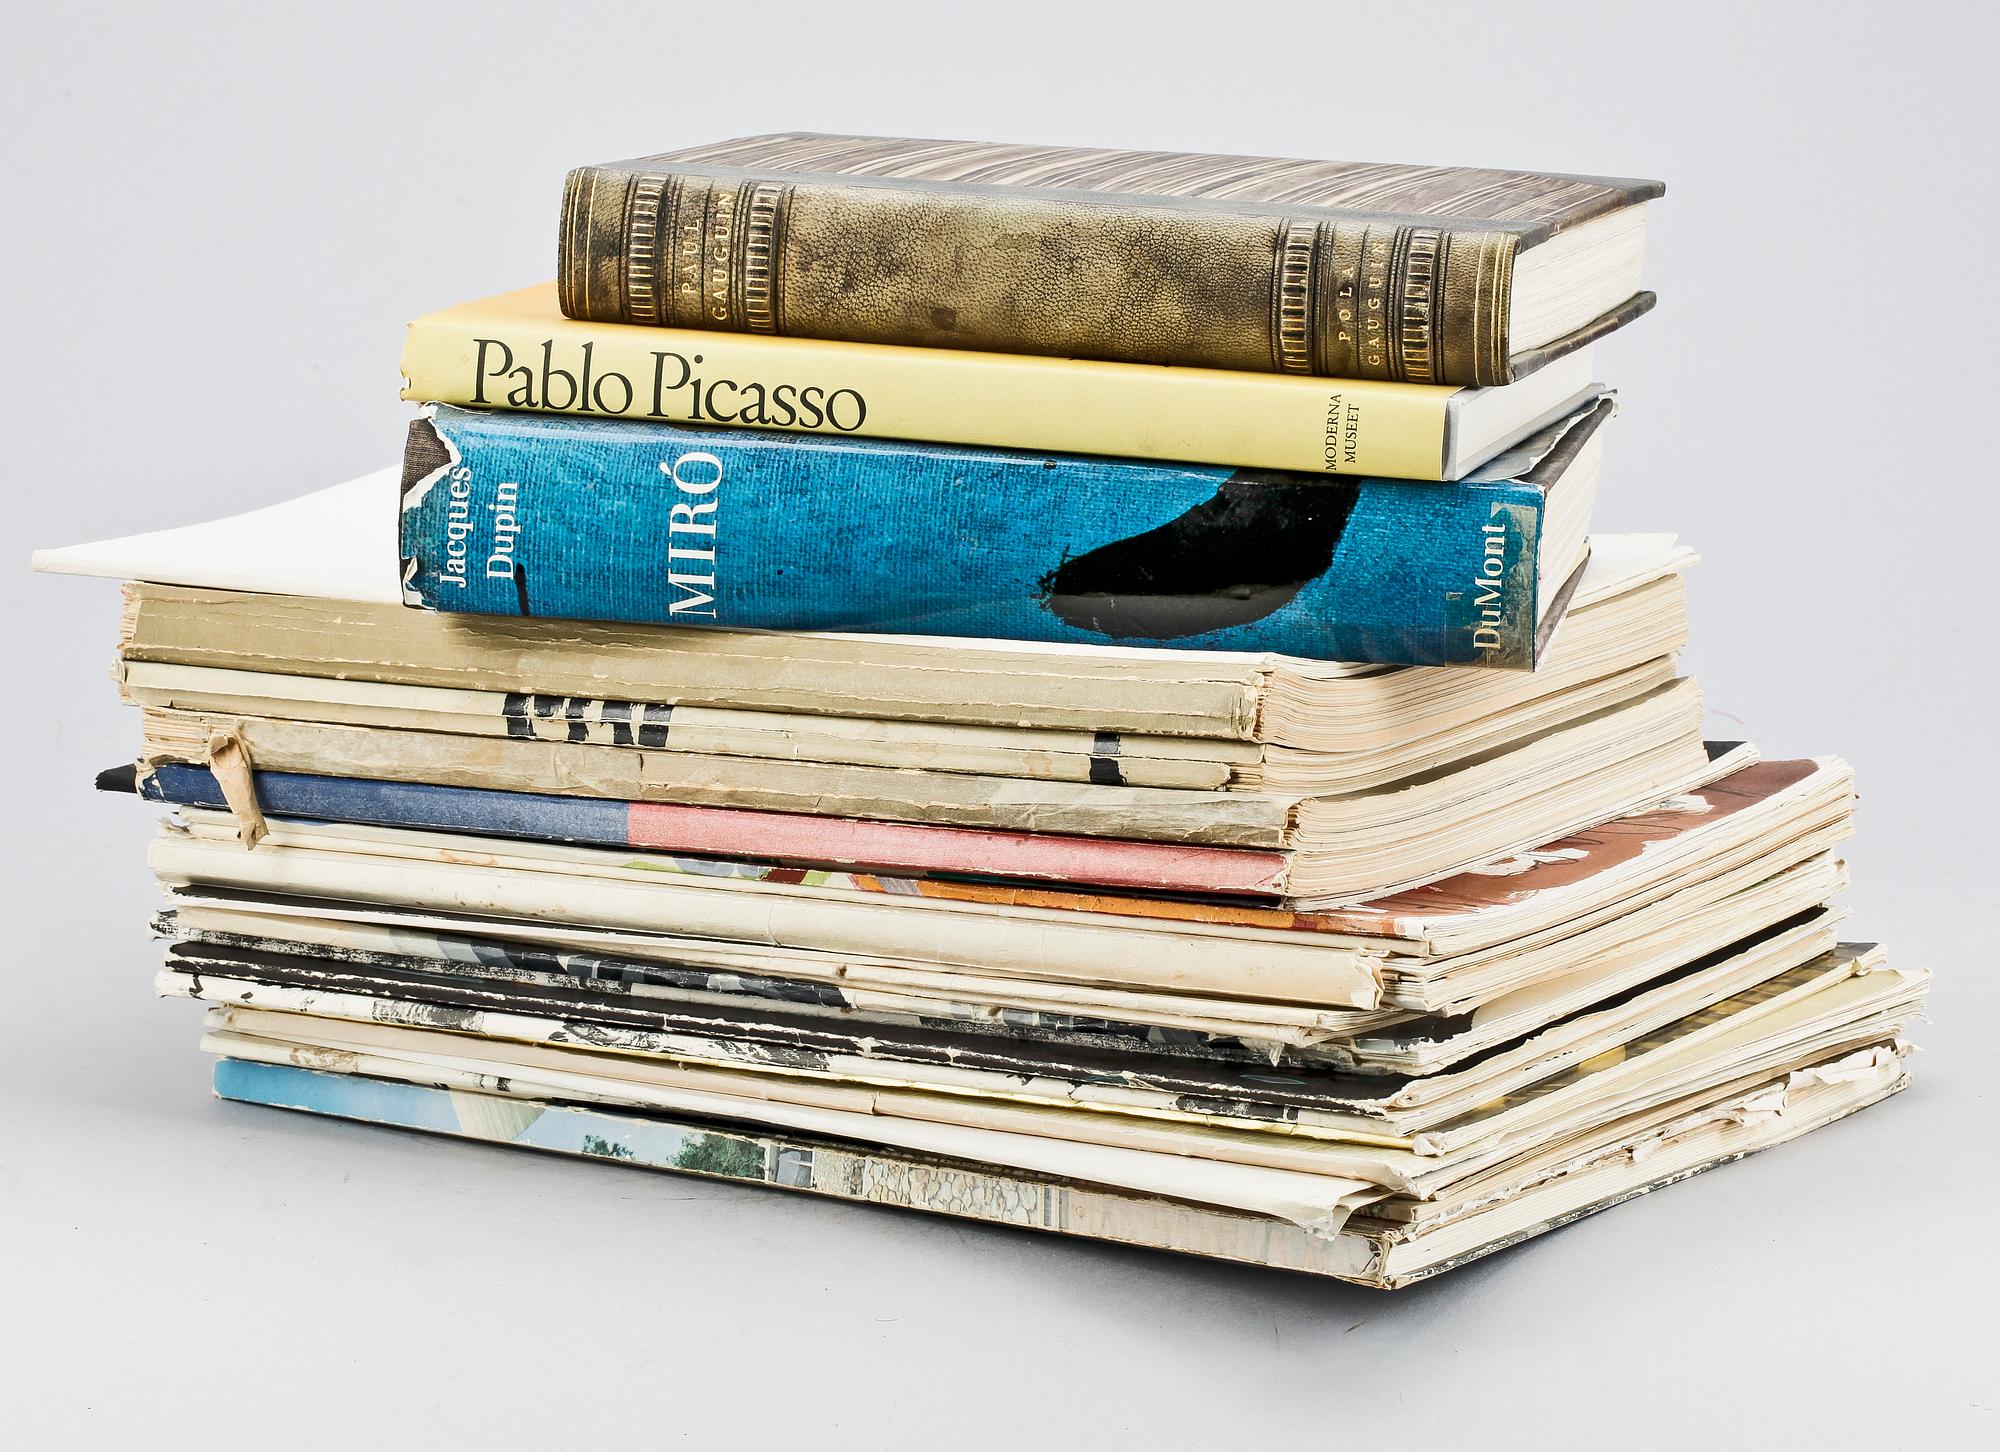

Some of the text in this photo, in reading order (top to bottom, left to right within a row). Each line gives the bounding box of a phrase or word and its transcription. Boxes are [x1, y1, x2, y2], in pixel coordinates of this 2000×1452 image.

[681, 218, 700, 295] PAUL
[712, 191, 734, 321] GAUGUIN
[1338, 265, 1354, 342] POLA
[469, 338, 868, 432] Pablo Picasso
[1324, 392, 1342, 472] MODERNA
[1344, 403, 1360, 464] MUSEET
[439, 467, 474, 588] Jacques
[486, 482, 523, 580] Dupin
[659, 452, 723, 618] MIRÓ
[1473, 523, 1506, 649] DuMont
